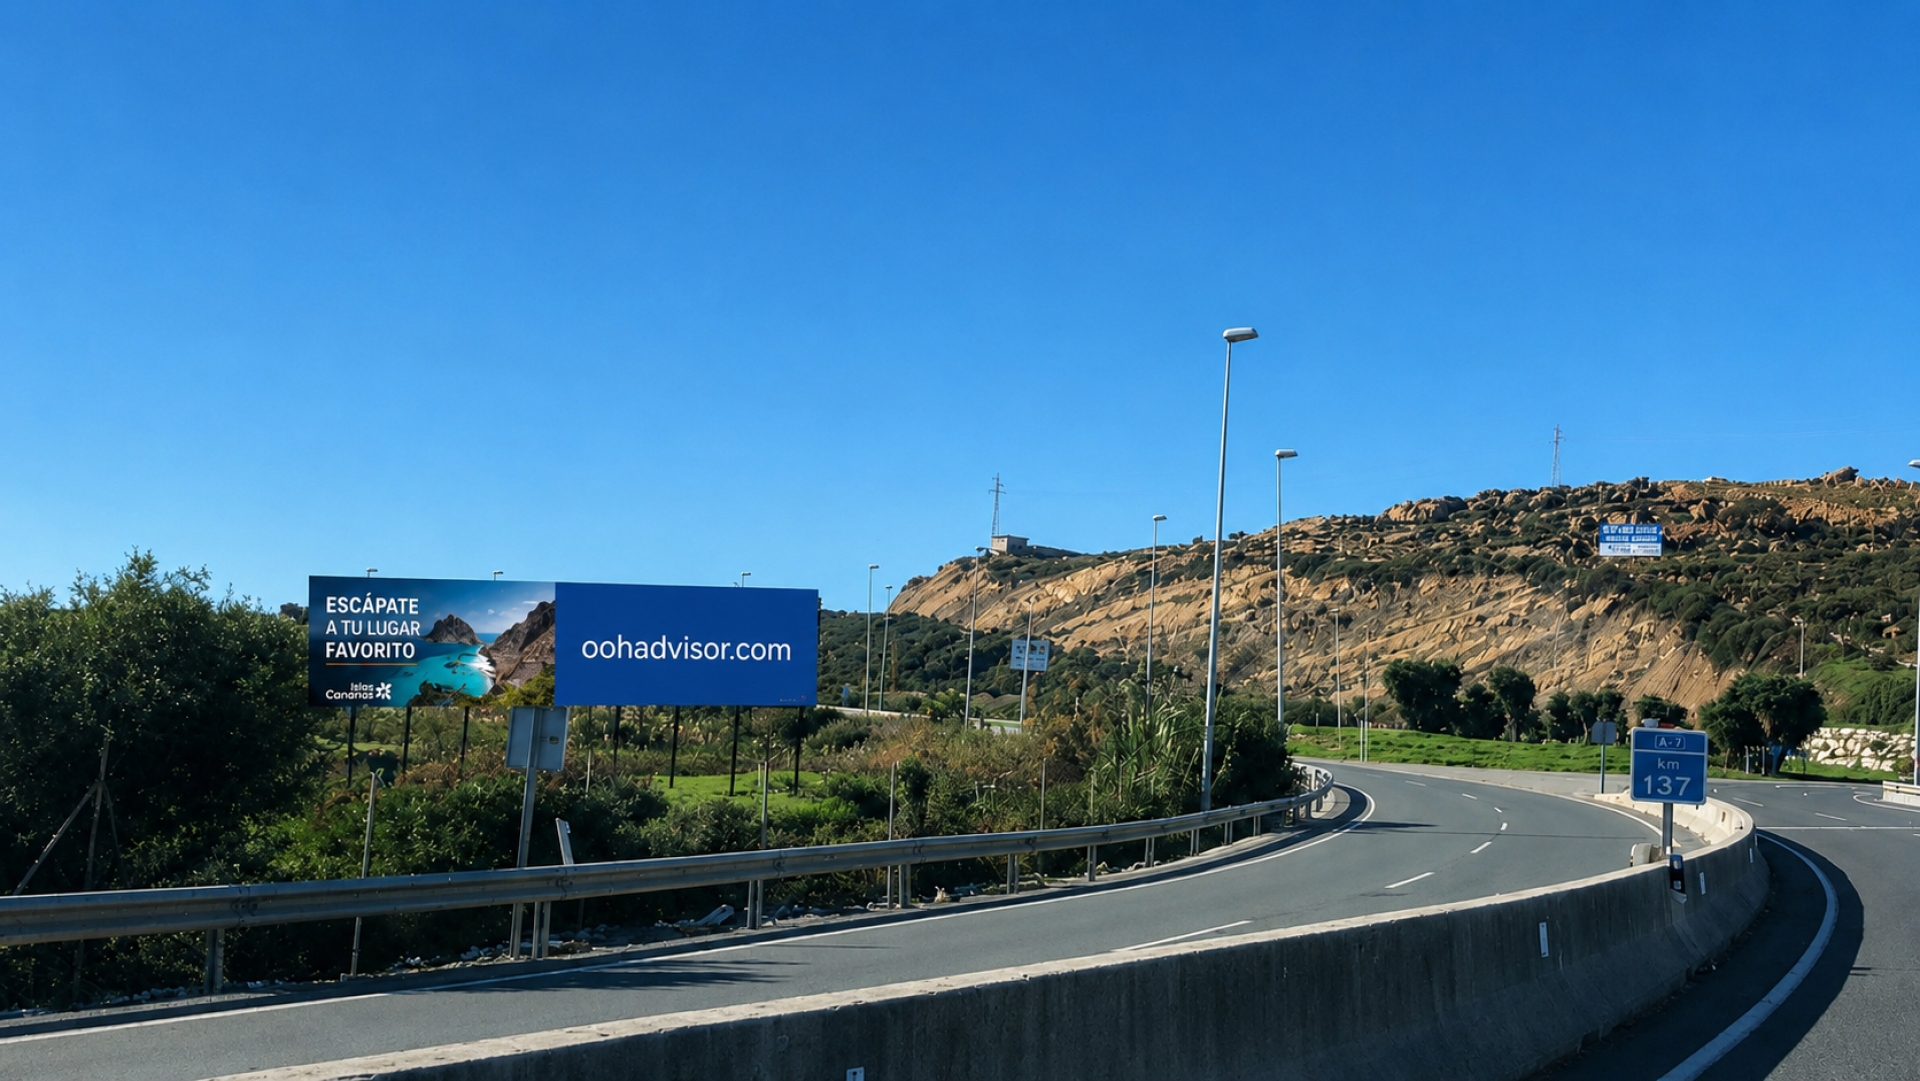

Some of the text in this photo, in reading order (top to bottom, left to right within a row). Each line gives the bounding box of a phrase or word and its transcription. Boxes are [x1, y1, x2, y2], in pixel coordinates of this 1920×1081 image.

[326, 592, 419, 615] ESCÁPATE
[325, 620, 420, 636] A TU LUGAR
[325, 642, 416, 659] FAVORITO
[582, 634, 791, 661] oohadvisor.com
[350, 682, 374, 692] Islas
[1658, 737, 1682, 748] A-7
[1657, 757, 1680, 770] km
[1643, 774, 1692, 797] 137
